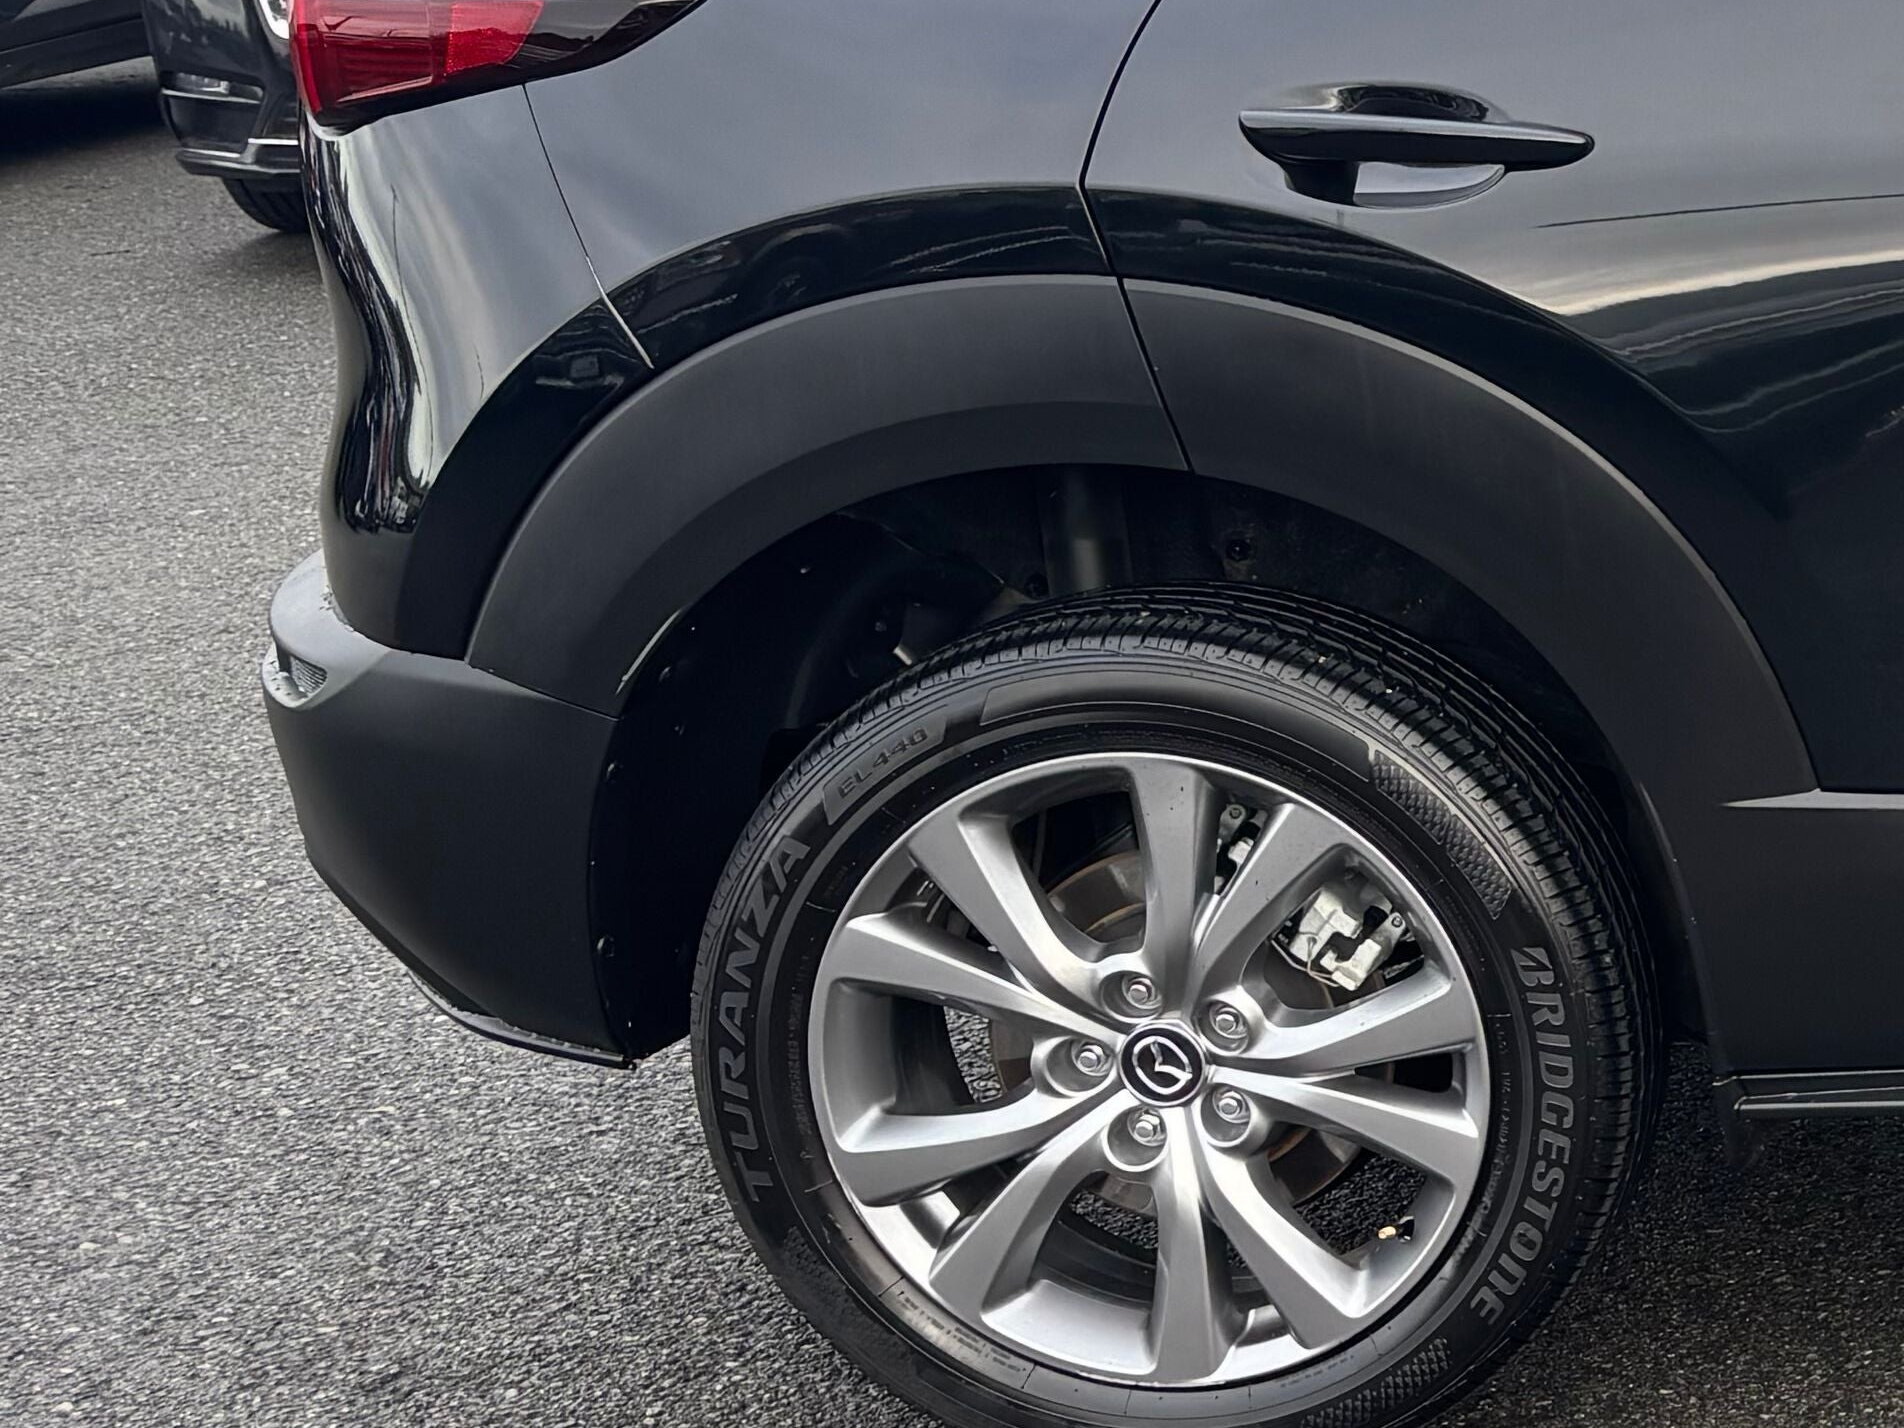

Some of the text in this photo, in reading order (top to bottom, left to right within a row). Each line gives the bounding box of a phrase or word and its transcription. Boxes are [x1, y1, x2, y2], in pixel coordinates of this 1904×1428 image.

[838, 728, 928, 799] EL 440
[718, 834, 811, 1203] TURANZA
[1470, 946, 1574, 1325] BRIDGESTONE
